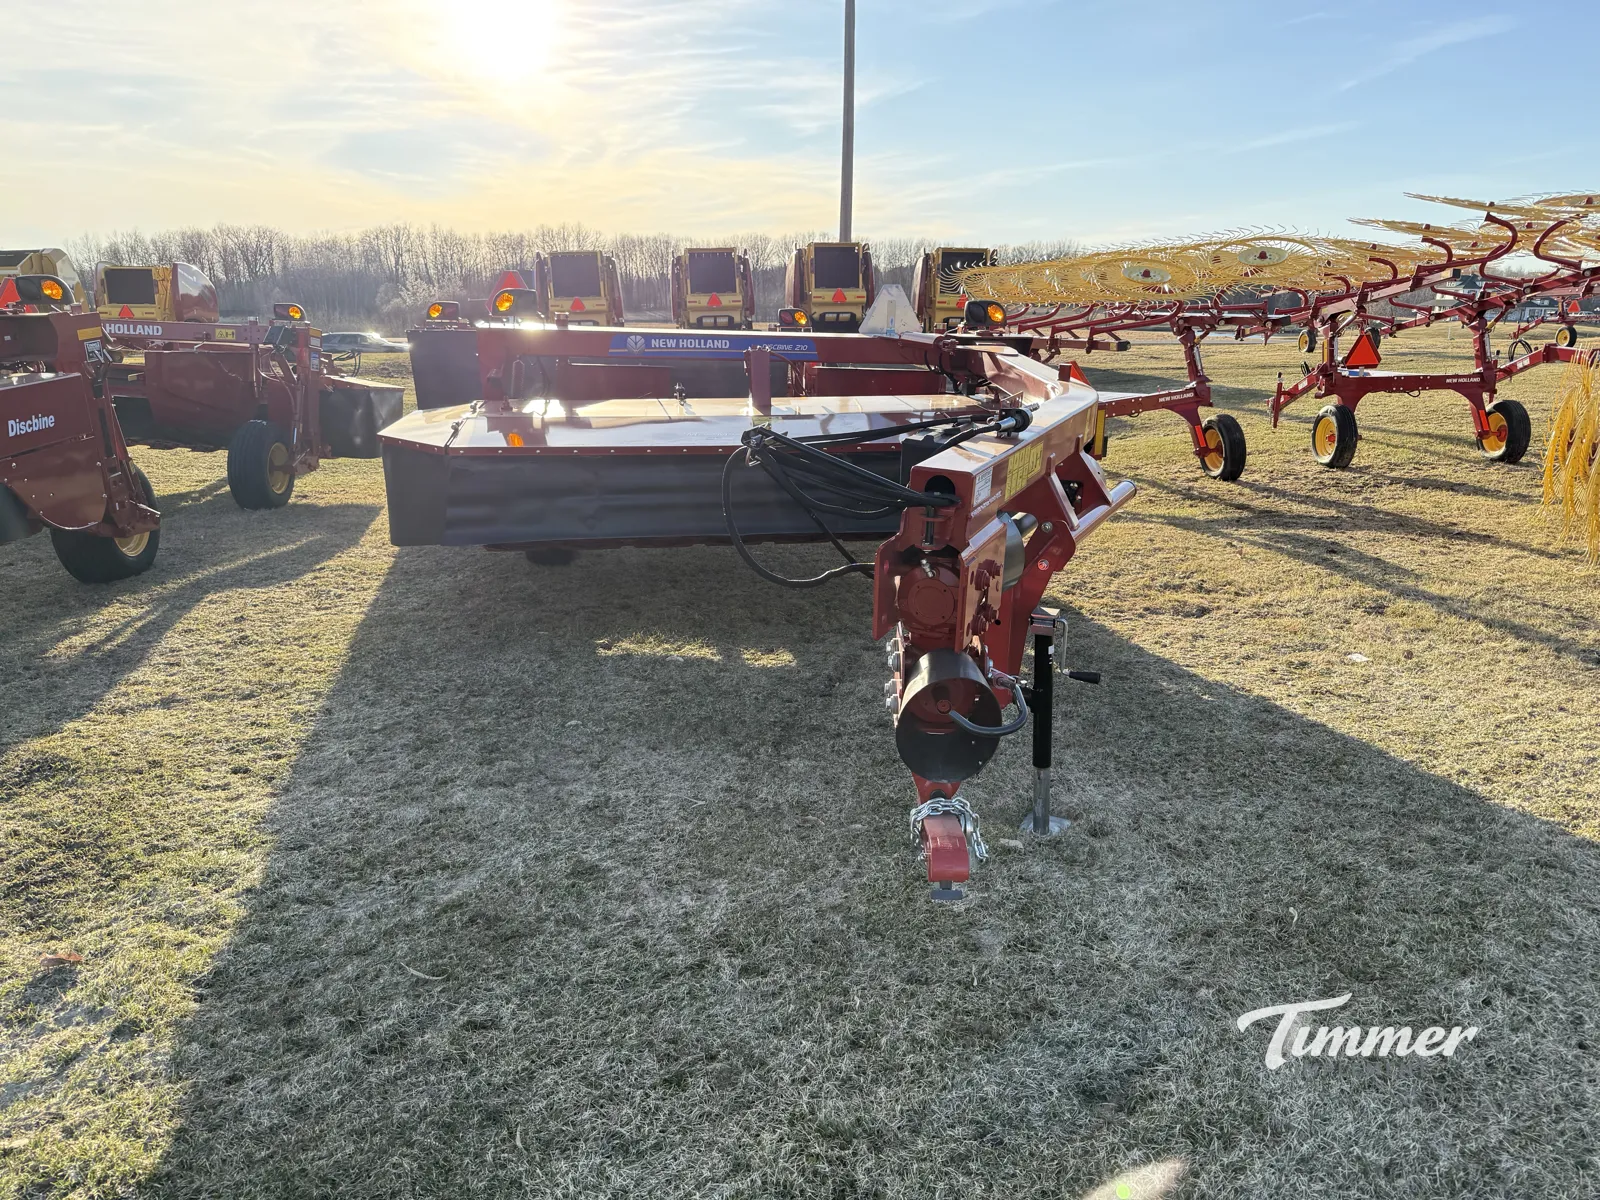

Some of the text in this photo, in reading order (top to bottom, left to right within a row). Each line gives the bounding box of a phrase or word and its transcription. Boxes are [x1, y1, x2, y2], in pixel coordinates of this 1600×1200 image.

[105, 323, 163, 336] HOLLAND
[651, 338, 730, 349] NEW HOLLAND
[1171, 392, 1194, 401] HOLLAND
[8, 413, 55, 437] Discbine
